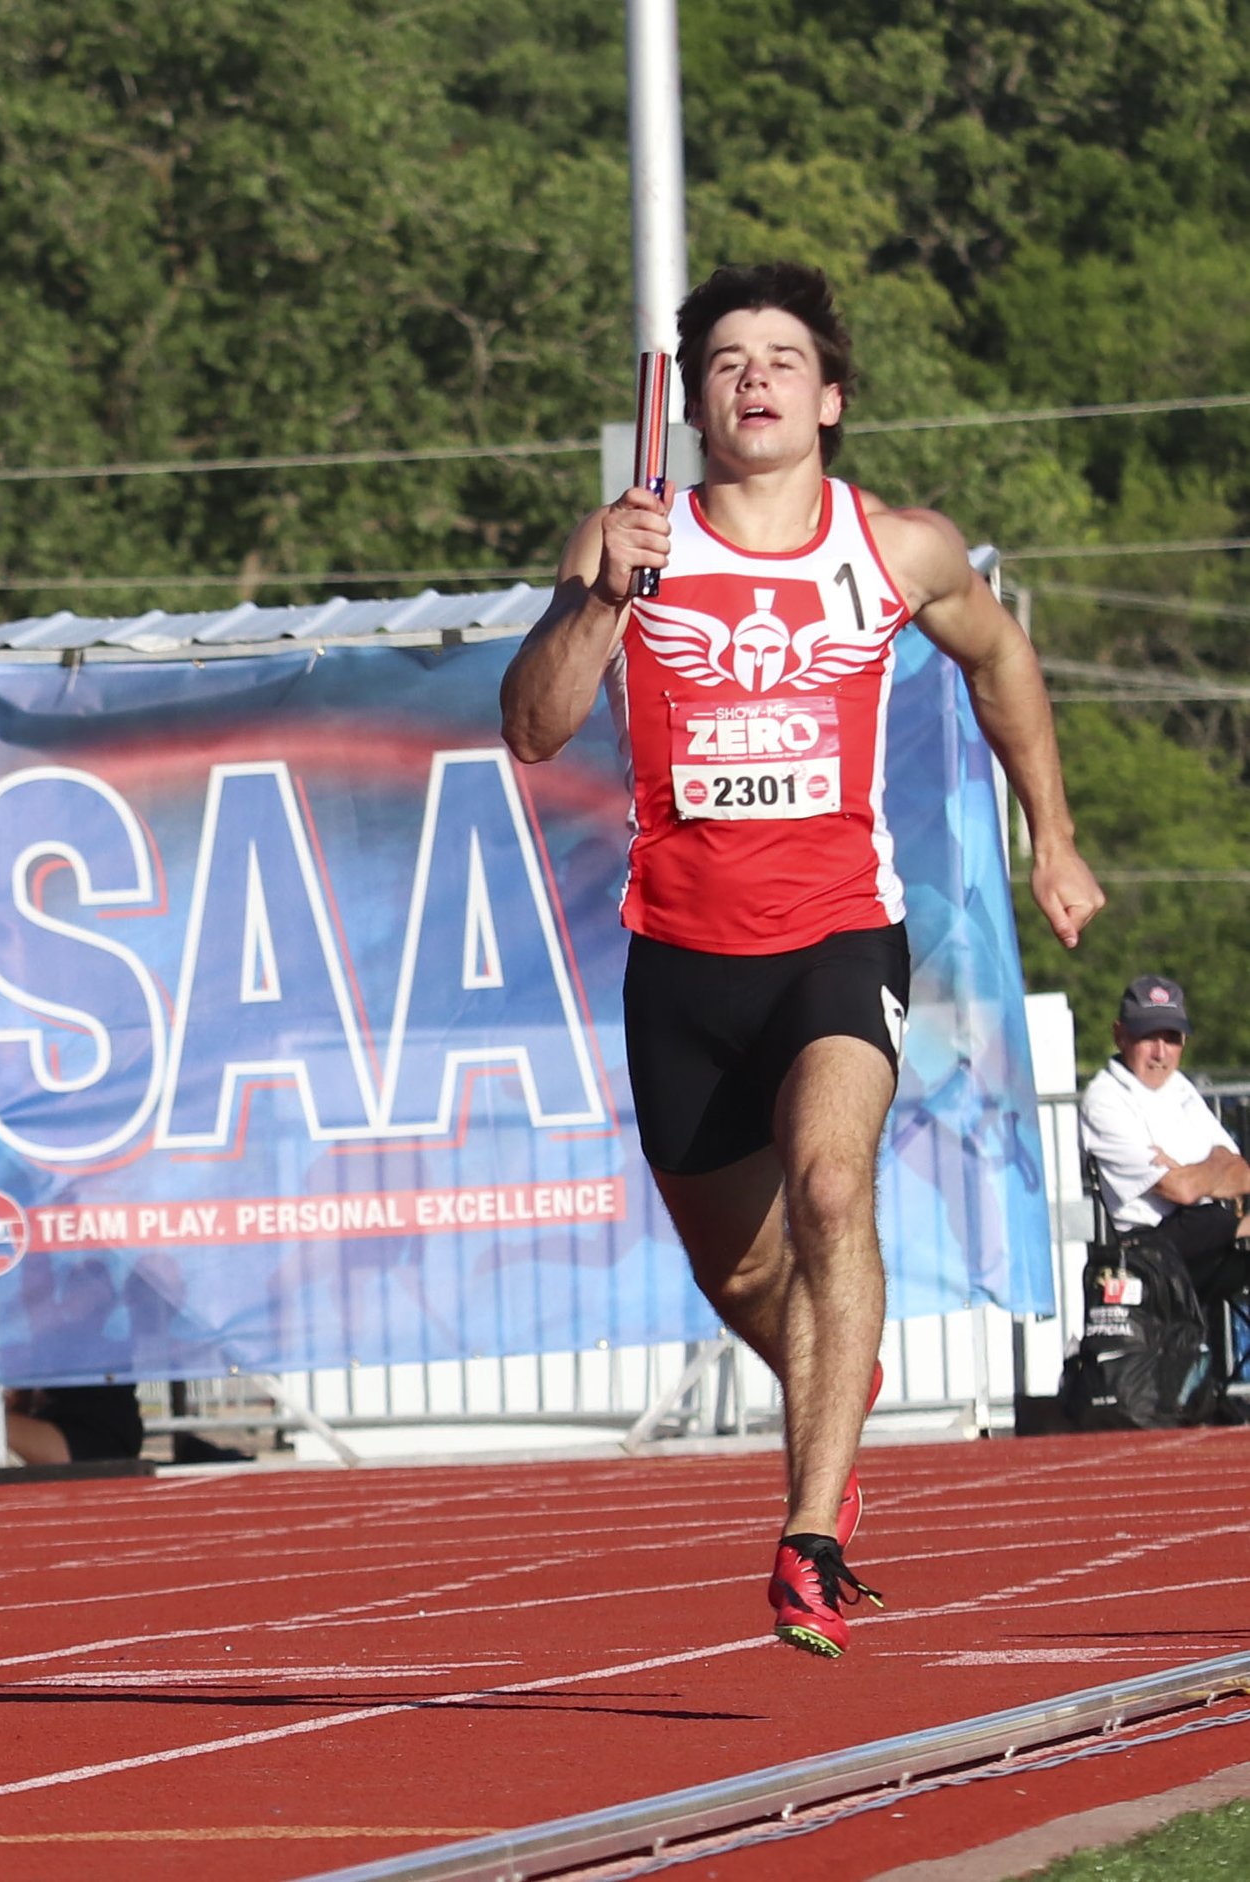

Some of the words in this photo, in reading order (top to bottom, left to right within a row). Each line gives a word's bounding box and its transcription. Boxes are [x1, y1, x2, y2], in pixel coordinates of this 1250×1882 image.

[833, 562, 865, 631] 1
[716, 704, 788, 720] SHOW-ME
[686, 713, 820, 755] ZERO
[713, 774, 796, 807] 2301
[38, 1208, 127, 1243] TEAM
[138, 1205, 225, 1238] PLAY.
[237, 1195, 403, 1234] PERSONAL
[415, 1183, 616, 1224] EXCELLENCE
